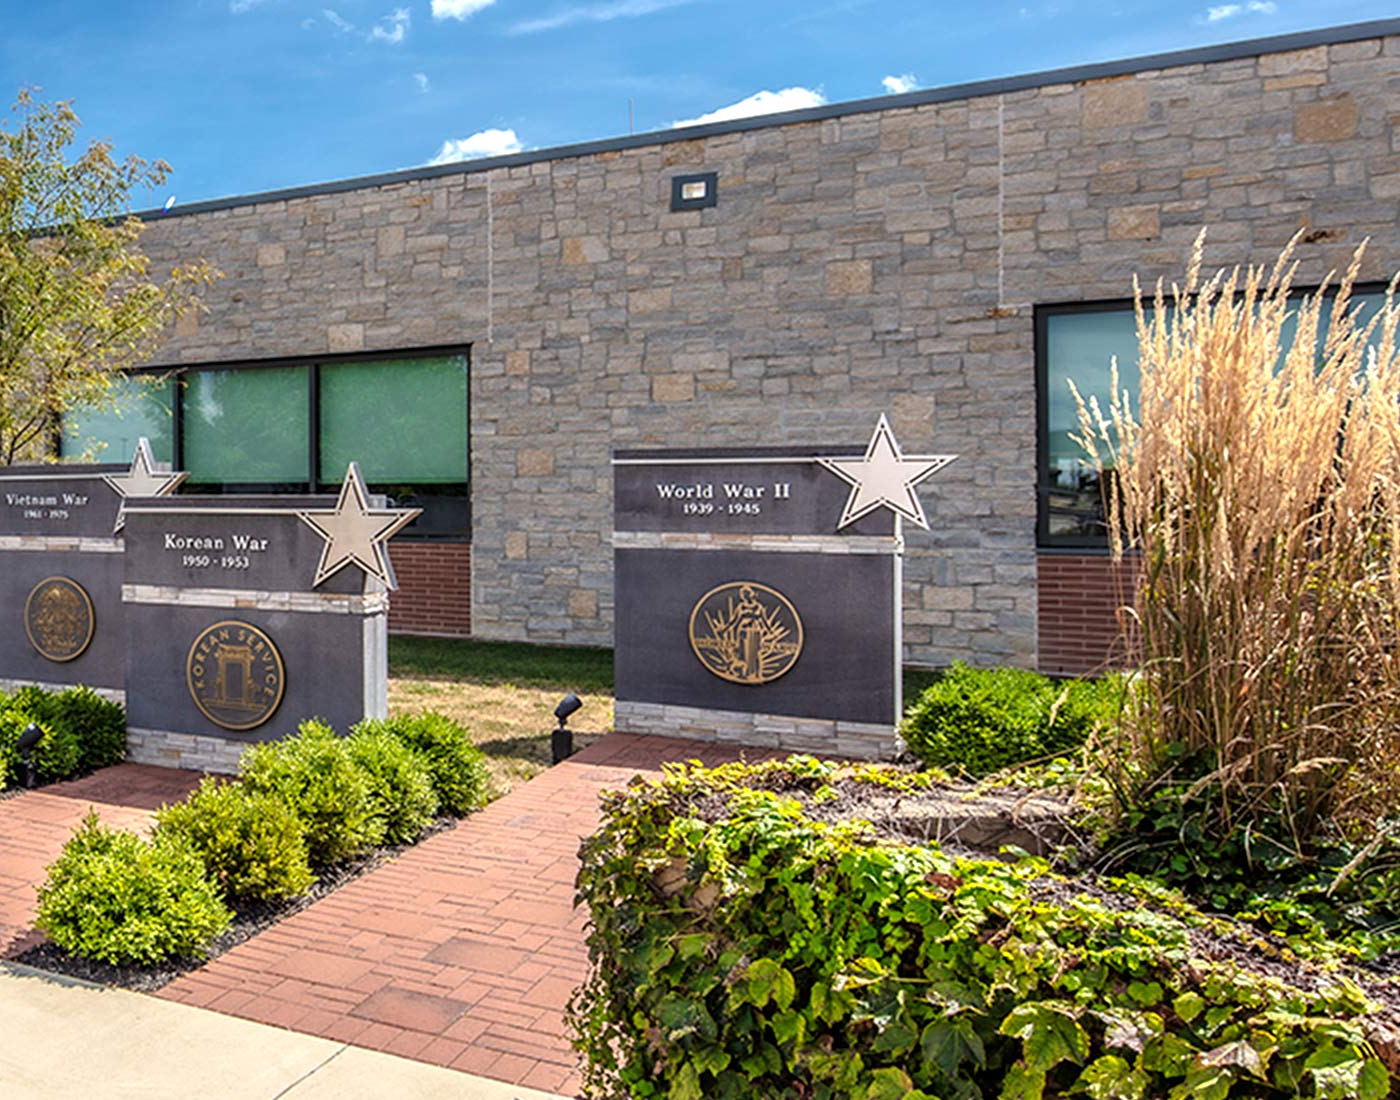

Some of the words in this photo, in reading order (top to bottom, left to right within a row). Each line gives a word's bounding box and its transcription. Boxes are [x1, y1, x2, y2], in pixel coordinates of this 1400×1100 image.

[656, 483, 714, 499] World
[723, 483, 765, 498] War
[774, 483, 790, 498] II
[5, 493, 58, 505] Vietnam
[62, 493, 88, 505] War
[683, 502, 714, 514] 1939
[728, 503, 760, 514] 1945
[164, 533, 224, 549] Korean
[232, 535, 268, 550] War
[183, 555, 210, 567] 1950
[221, 556, 249, 569] 1953
[192, 629, 230, 688] KOREAN
[237, 629, 278, 697] SERVICE
